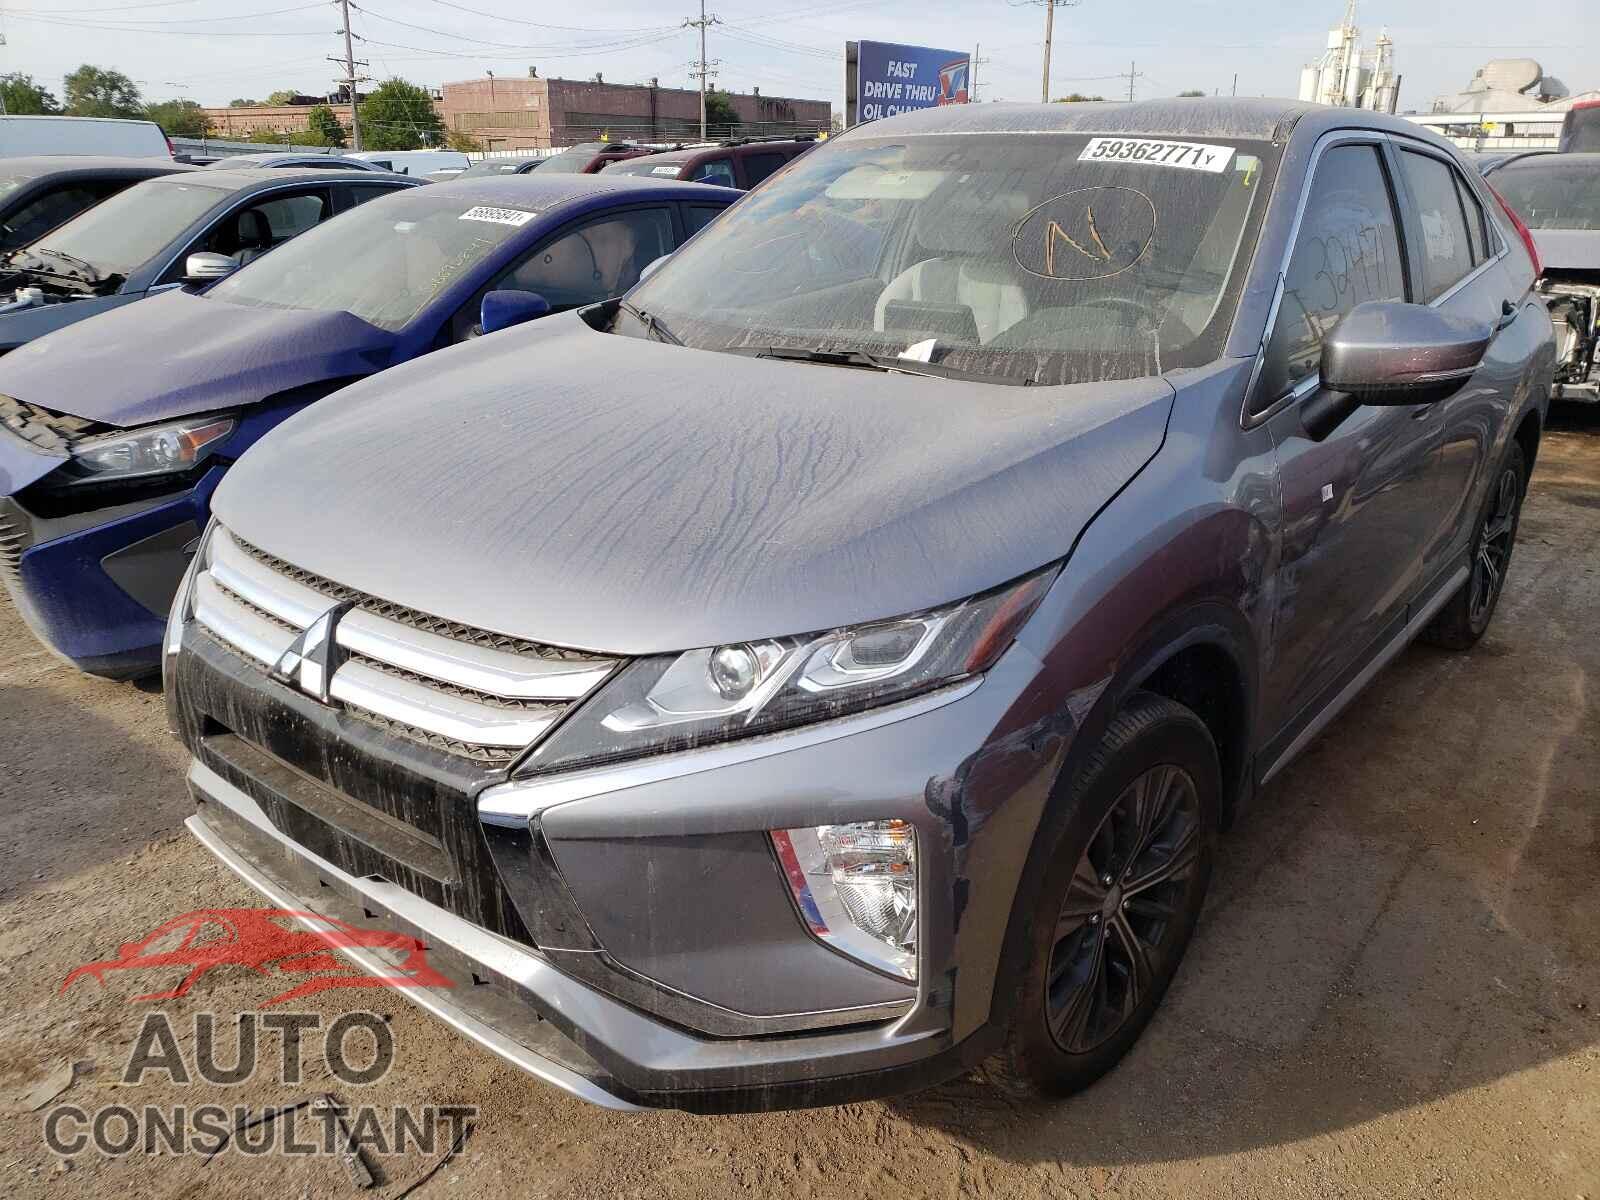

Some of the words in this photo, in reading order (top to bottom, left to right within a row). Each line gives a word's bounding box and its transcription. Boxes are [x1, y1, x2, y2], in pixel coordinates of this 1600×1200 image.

[887, 60, 917, 78] FAST
[864, 81, 902, 98] DRIVE
[904, 84, 936, 101] THRU
[863, 103, 883, 120] OIL
